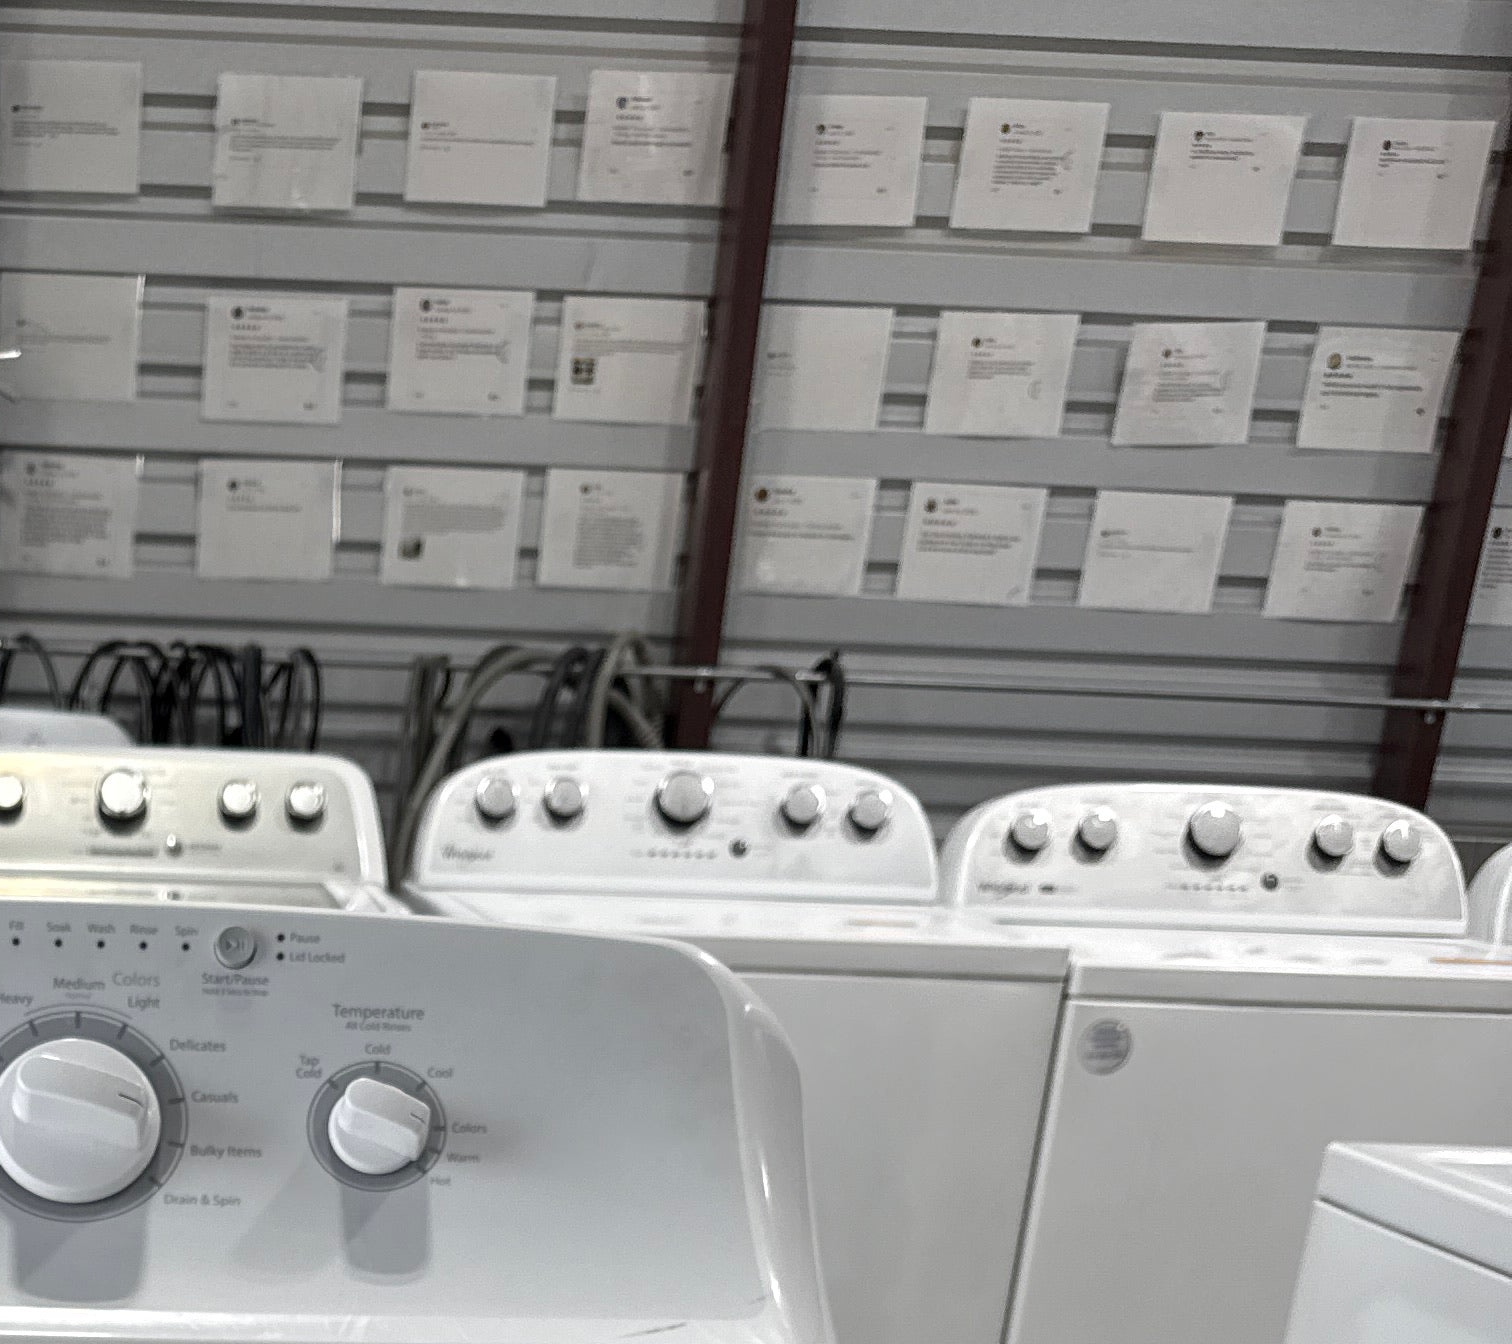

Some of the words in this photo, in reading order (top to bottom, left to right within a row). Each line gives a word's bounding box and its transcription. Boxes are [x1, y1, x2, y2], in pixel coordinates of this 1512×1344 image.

[290, 932, 321, 944] Pause
[52, 977, 106, 991] Medium
[112, 971, 161, 988] Colors
[201, 973, 270, 986] Start/Pause
[127, 997, 161, 1010] Light
[333, 1004, 425, 1023] Temperature
[169, 1039, 227, 1052] Delicates
[364, 1043, 392, 1056] Cold
[295, 1068, 323, 1080] Cold
[427, 1067, 455, 1079] Cool
[191, 1091, 239, 1103] Casuals
[451, 1122, 488, 1134] Colors
[190, 1145, 225, 1159] Bulky
[227, 1145, 263, 1158] Items
[447, 1153, 481, 1164] Warm
[163, 1194, 198, 1206] Drain
